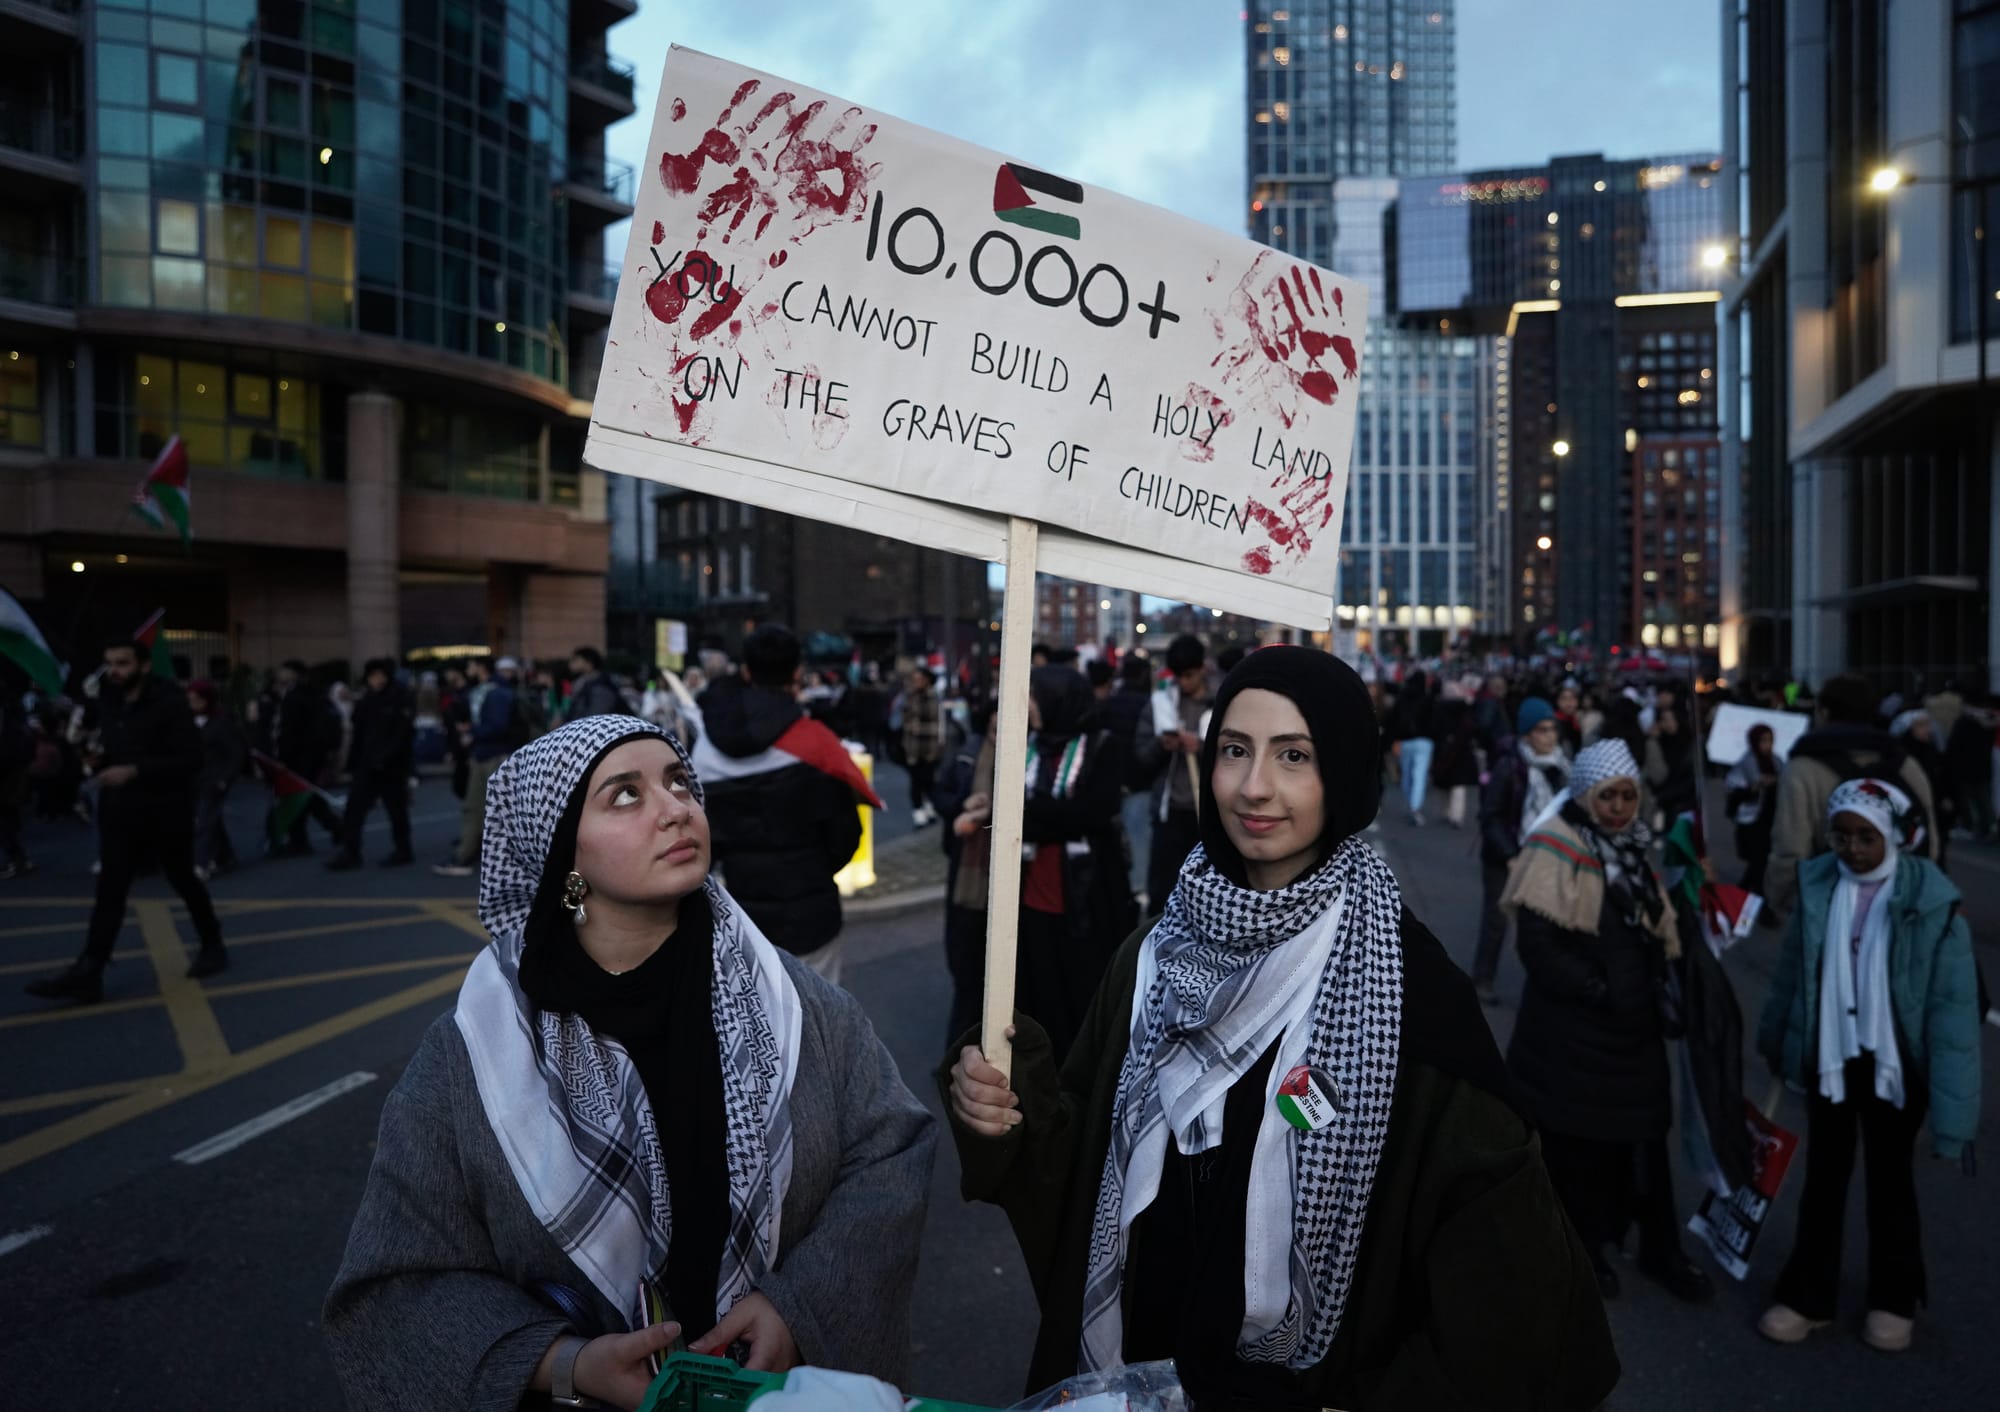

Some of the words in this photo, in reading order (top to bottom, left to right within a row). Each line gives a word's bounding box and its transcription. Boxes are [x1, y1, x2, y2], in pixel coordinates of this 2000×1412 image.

[866, 190, 1181, 340] 10,000+
[649, 246, 735, 304] YOU
[781, 280, 938, 358] CANNOT
[970, 332, 1069, 393] BUILD
[1089, 373, 1113, 412] A
[1153, 393, 1228, 449] HOLY
[1251, 426, 1333, 482] LAND
[683, 356, 743, 403] ON
[774, 368, 849, 419] THE
[882, 399, 1016, 459] GRAVES
[1047, 440, 1091, 481] OF
[1118, 466, 1252, 535] CHILDREN
[1307, 1085, 1322, 1107] FREE
